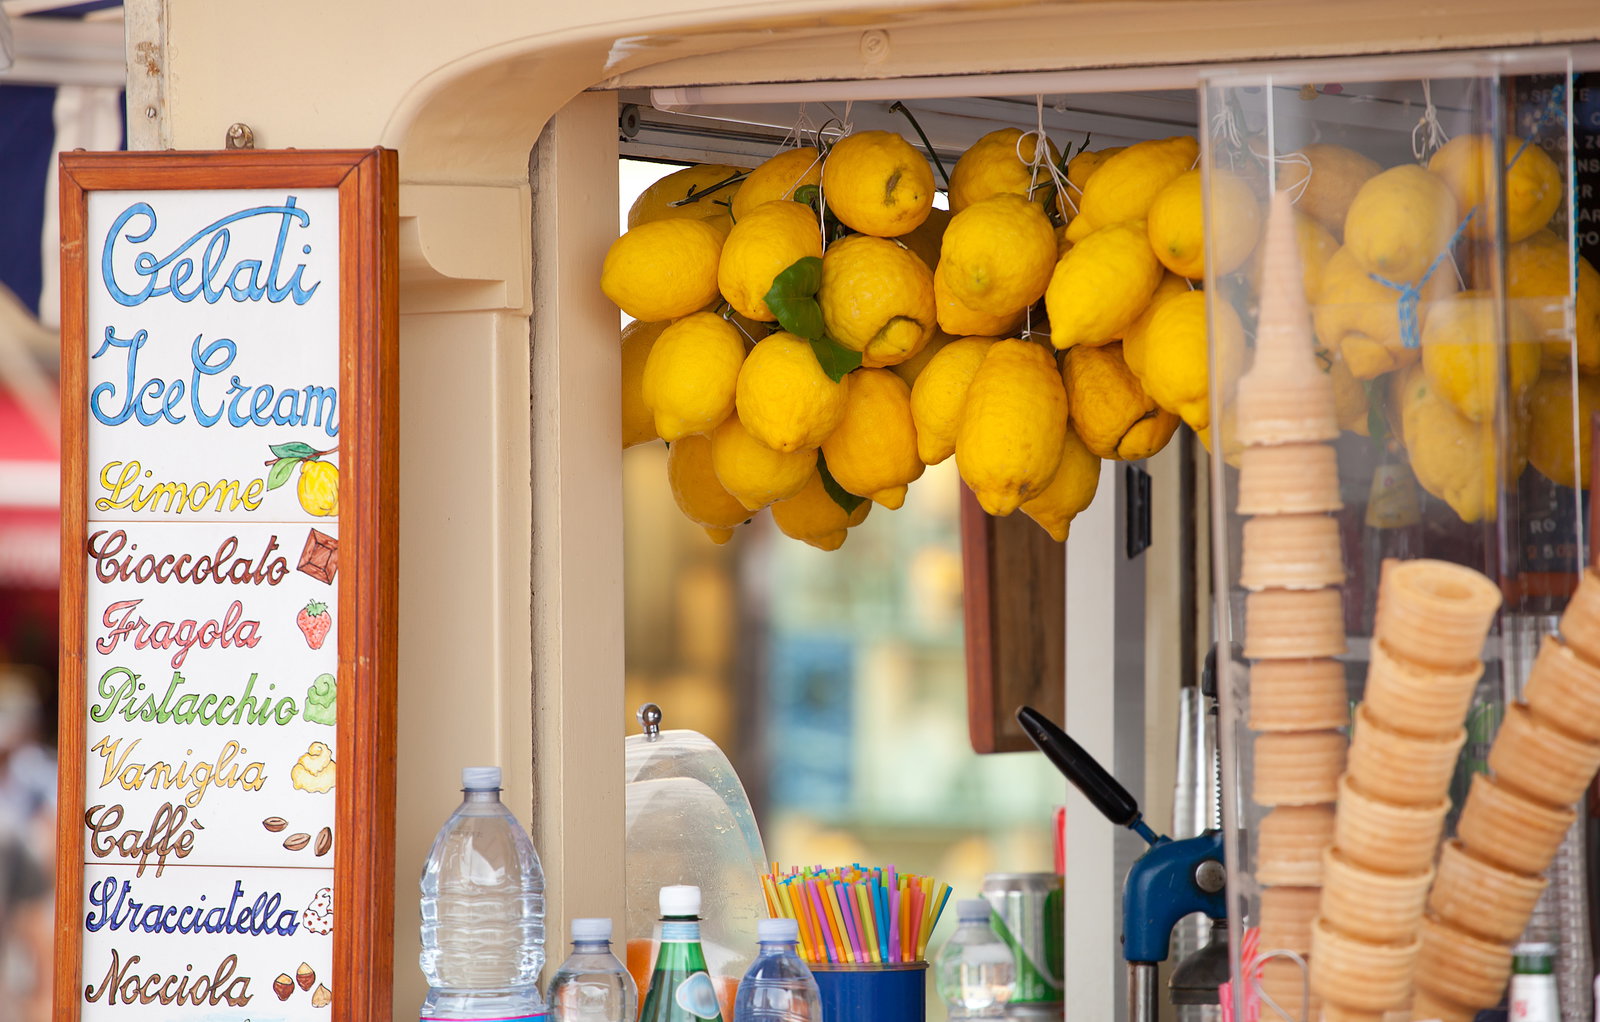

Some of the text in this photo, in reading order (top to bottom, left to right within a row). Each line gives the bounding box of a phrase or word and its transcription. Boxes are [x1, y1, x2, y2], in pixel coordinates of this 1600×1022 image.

[102, 195, 321, 307] Gelati
[91, 326, 339, 437] Ice Cream
[95, 460, 263, 514] Limone
[87, 529, 289, 586] Cioccolato
[96, 599, 262, 669] Fragola
[90, 666, 299, 727] Pistacchio
[91, 735, 268, 808] Vaniglia
[84, 801, 205, 878] Caffè
[85, 876, 300, 936] Stracciatella
[84, 948, 254, 1007] Nocciola
